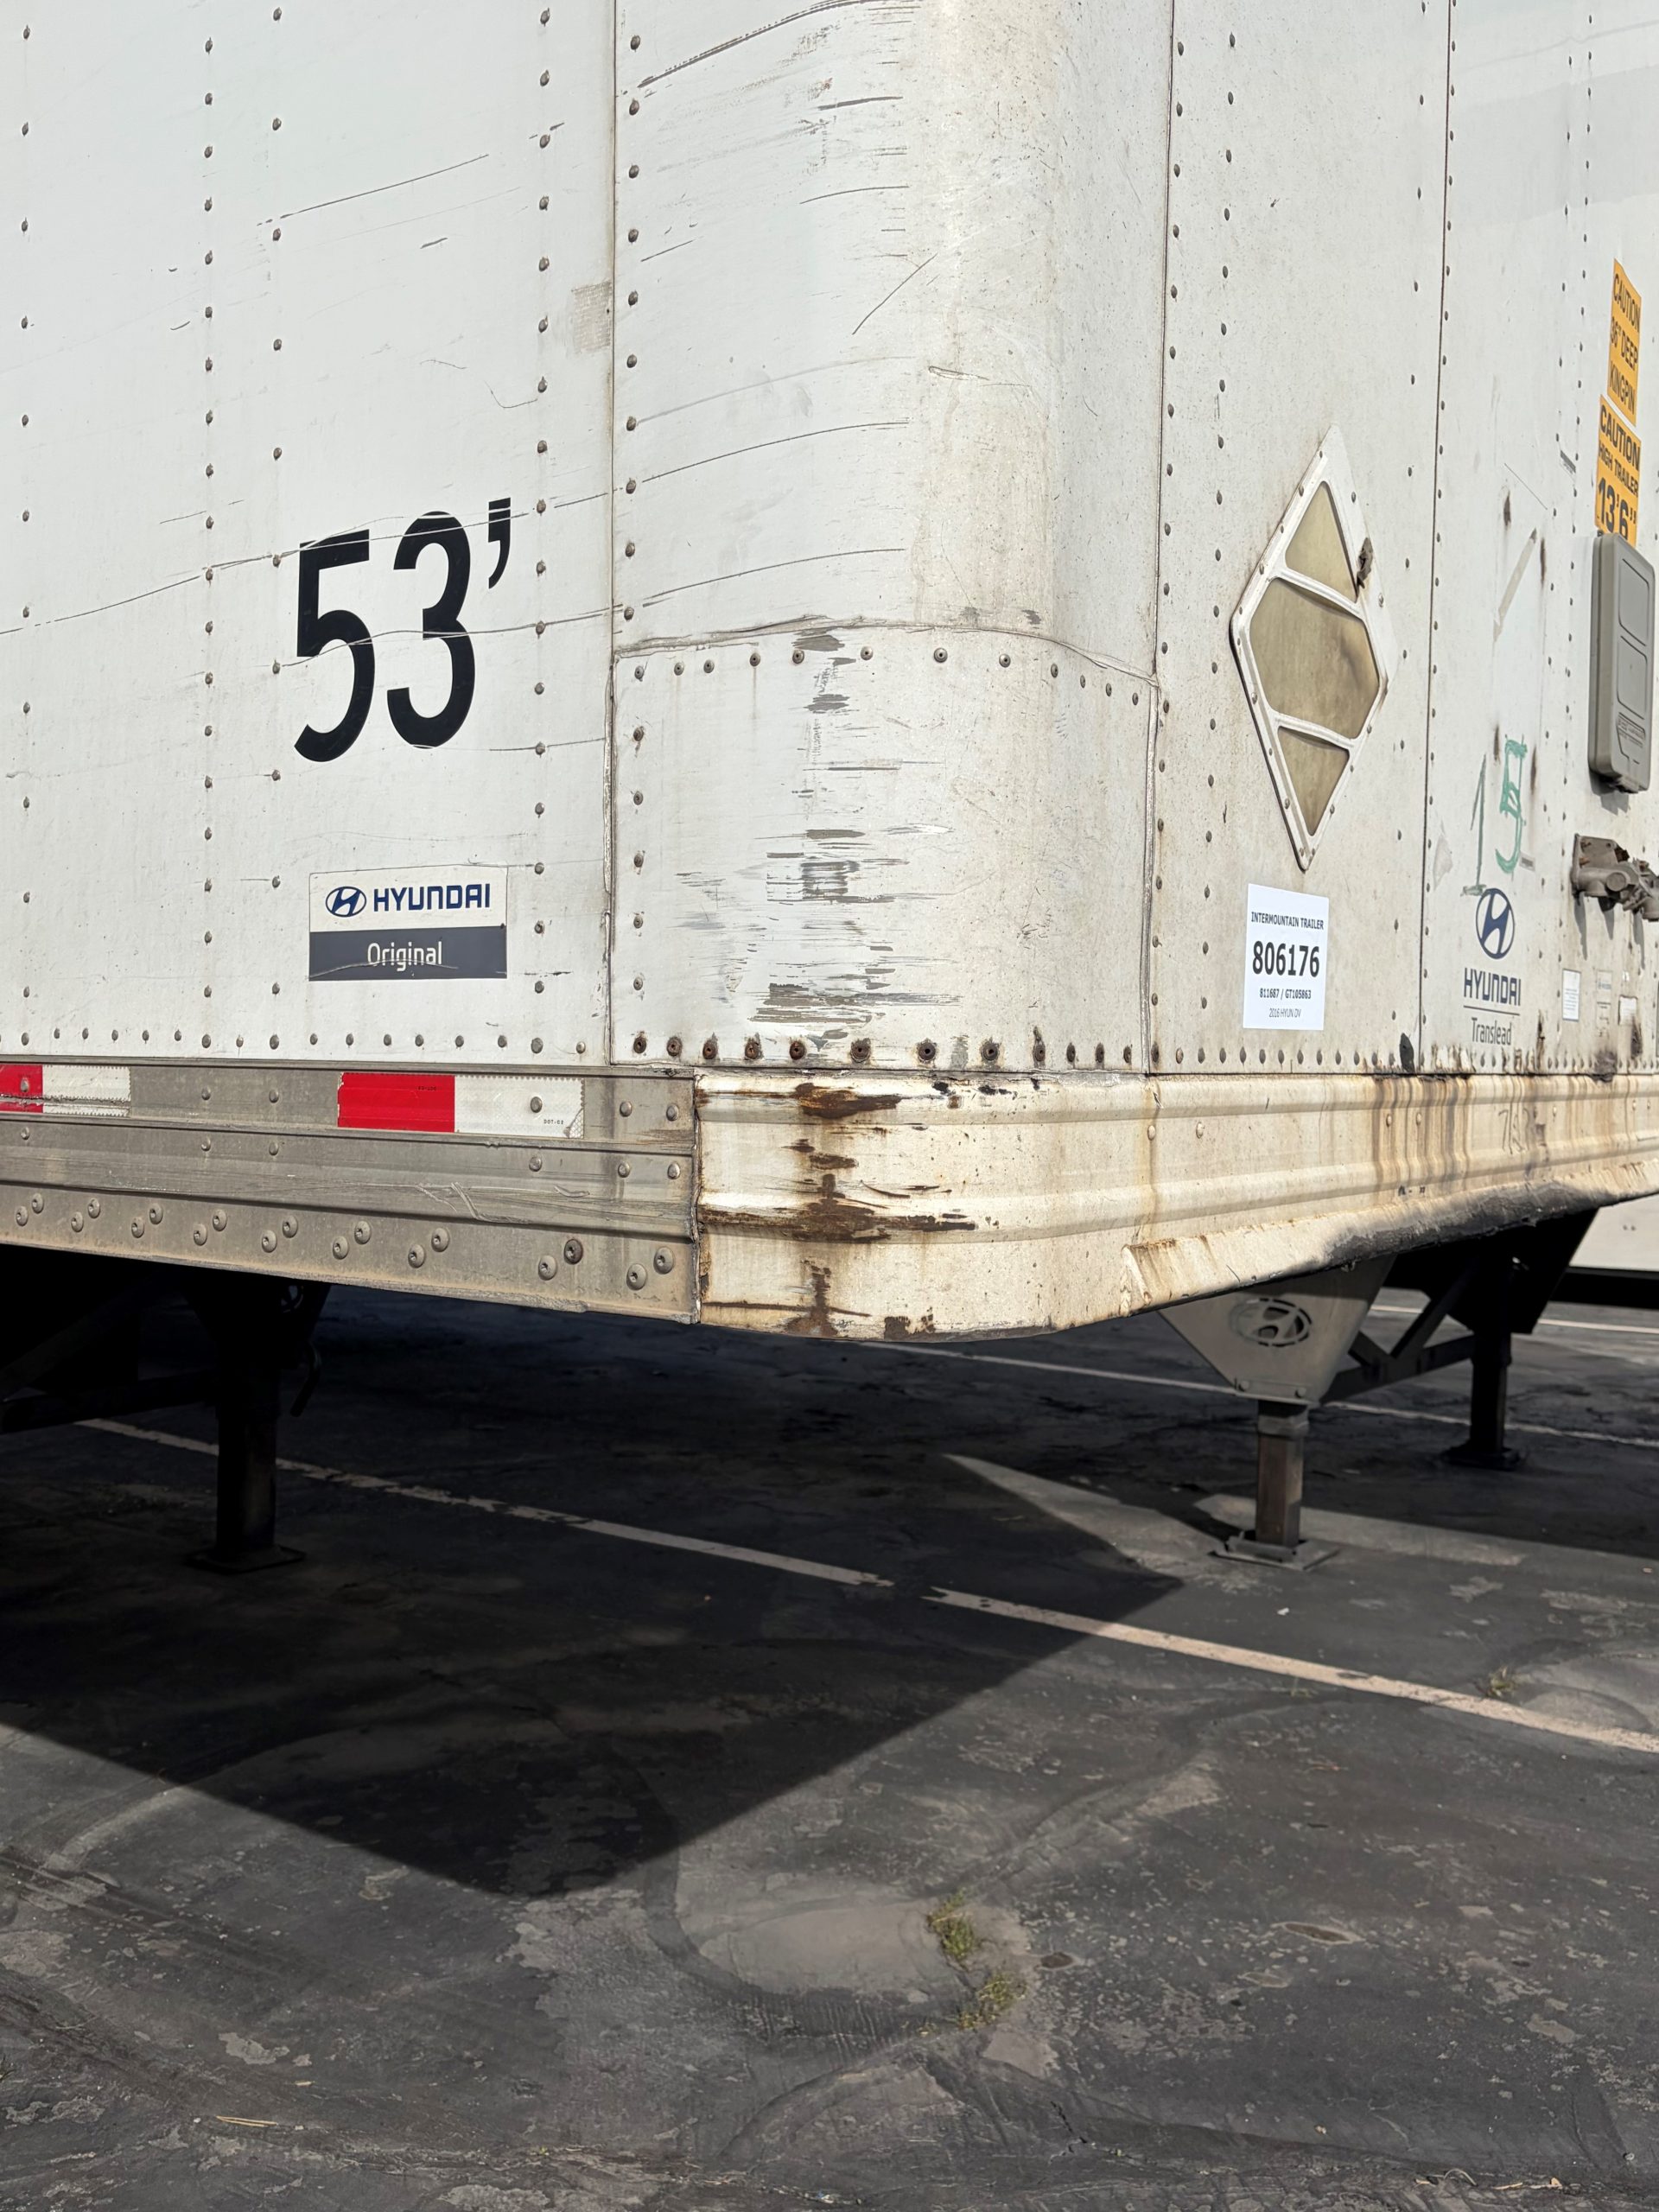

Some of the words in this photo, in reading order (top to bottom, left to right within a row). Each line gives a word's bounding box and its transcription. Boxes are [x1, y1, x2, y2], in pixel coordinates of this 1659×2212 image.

[1613, 273, 1640, 333] CAUTION
[1621, 330, 1638, 371] DEEP
[1609, 360, 1635, 415] KINGPIN
[1600, 404, 1640, 471] CAUTION
[1599, 440, 1612, 471] HIGH
[1614, 459, 1638, 498] TRAILER
[294, 497, 511, 762] 53'
[373, 883, 491, 912] HYUNDAI
[1251, 912, 1300, 927] INTERMOUNTAIN
[1300, 918, 1324, 930] TRAILER
[367, 942, 442, 971] Original
[1252, 940, 1320, 977] 806176
[1464, 967, 1522, 1007] HYUNDAI
[1268, 1007, 1280, 1018] 2016
[1281, 1007, 1294, 1018] HYUN
[1471, 1017, 1512, 1046] Translead
